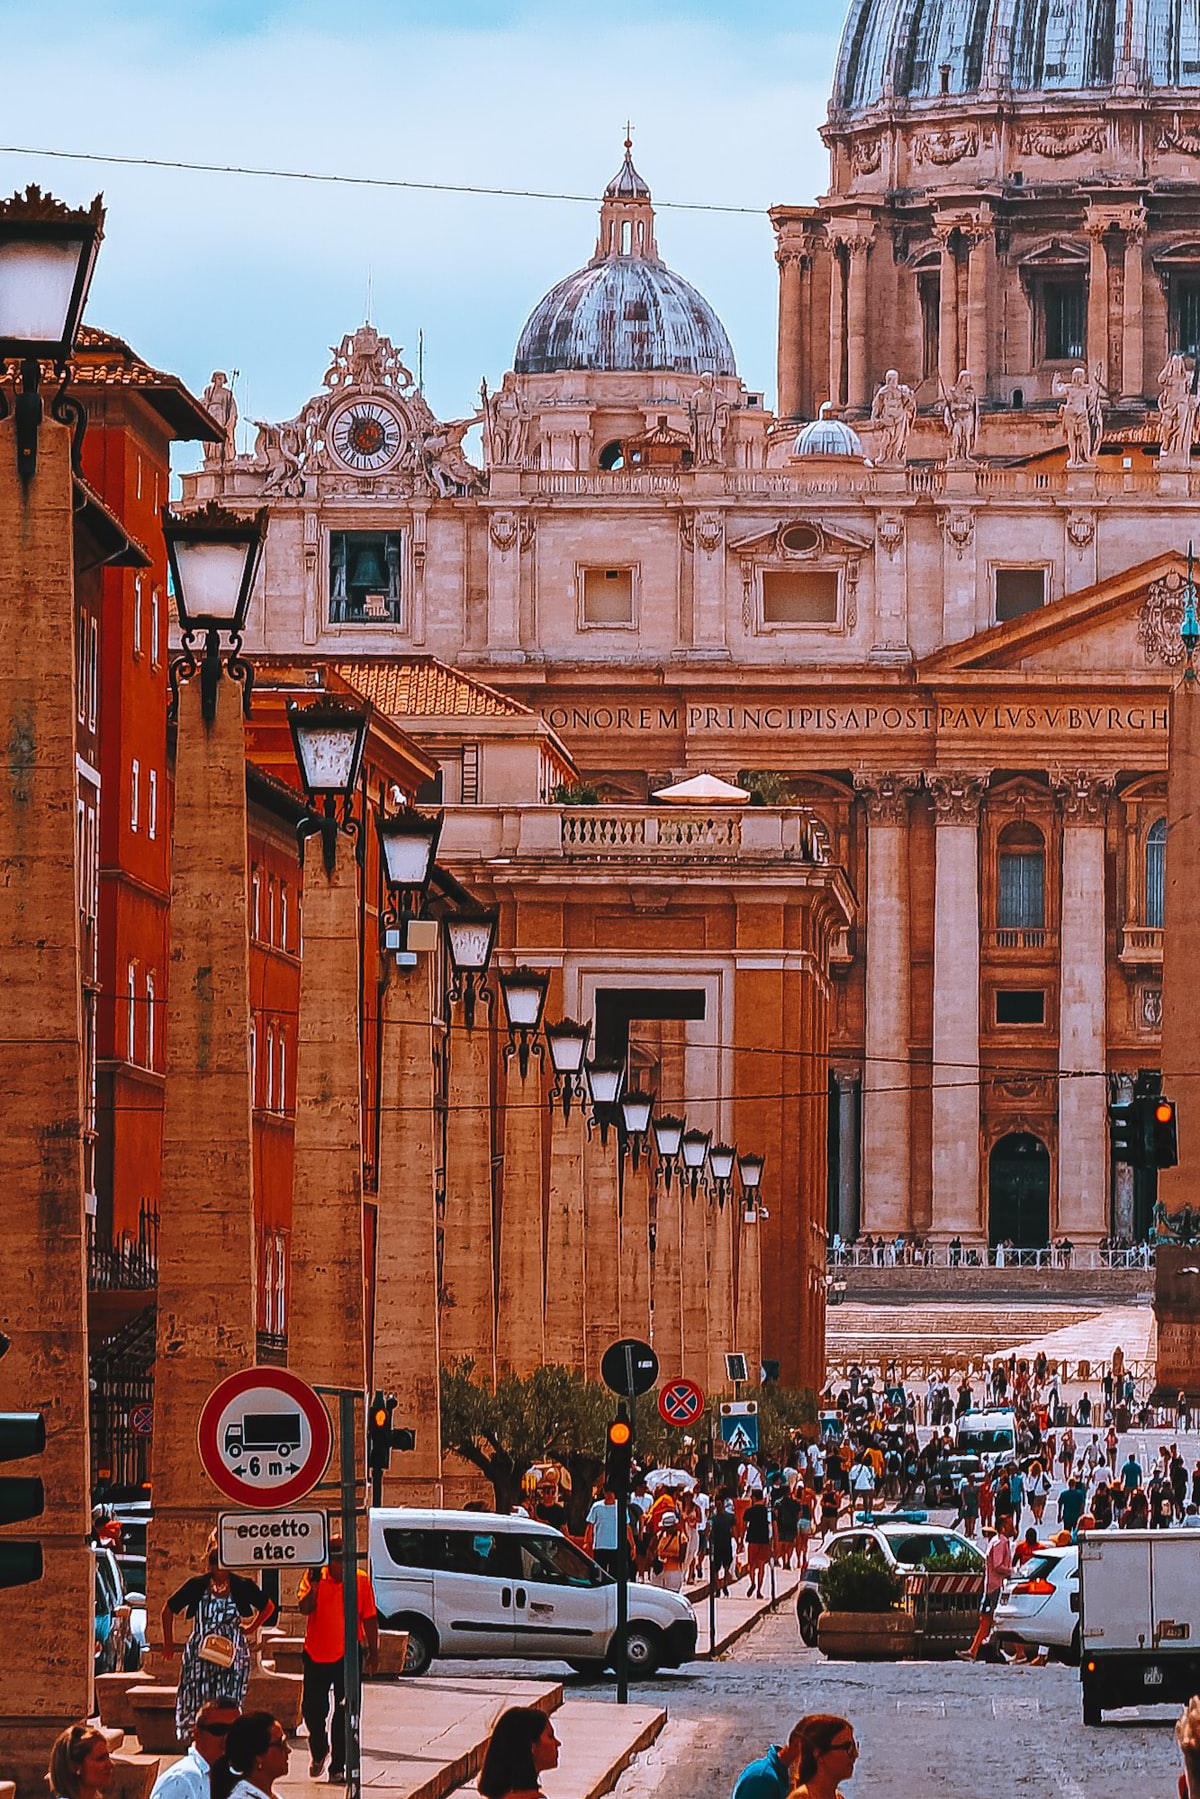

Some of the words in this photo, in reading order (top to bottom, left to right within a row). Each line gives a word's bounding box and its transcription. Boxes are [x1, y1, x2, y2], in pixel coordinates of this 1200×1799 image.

[688, 708, 838, 729] PRINCIPIS
[842, 707, 934, 729] APOST
[940, 707, 1037, 729] PAVLVS
[249, 1457, 260, 1477] 6
[269, 1461, 282, 1476] m
[237, 1519, 310, 1539] eccetto
[253, 1544, 295, 1561] atac
